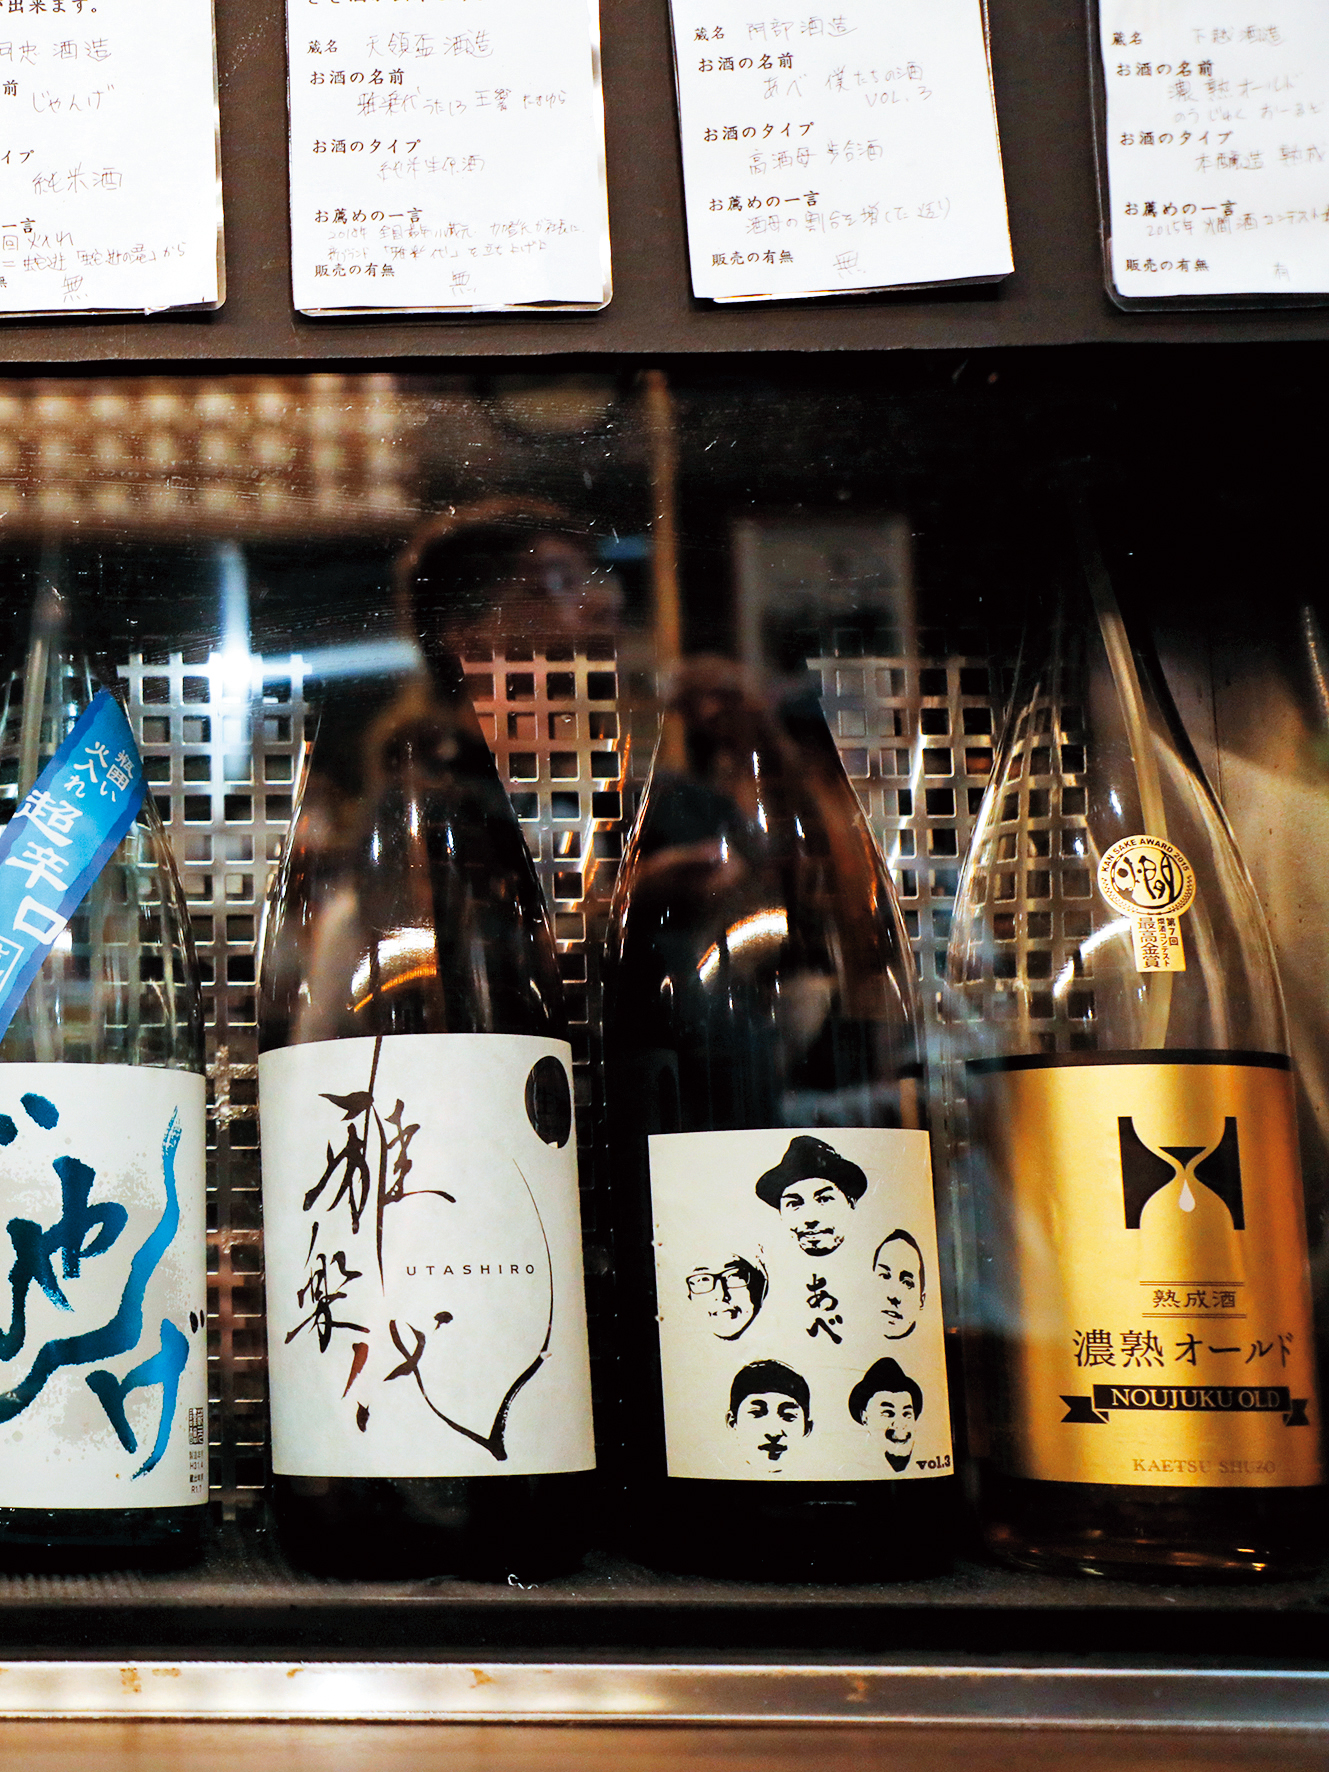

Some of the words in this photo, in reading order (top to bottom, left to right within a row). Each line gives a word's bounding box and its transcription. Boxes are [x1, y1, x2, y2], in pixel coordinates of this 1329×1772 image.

[693, 26, 725, 42] 蔵名
[1112, 31, 1143, 46] 蔵名
[307, 40, 338, 55] 蔵名
[698, 52, 794, 72] お酒の名前
[1116, 59, 1215, 78] お酒の名前
[310, 69, 405, 86] お酒の名前
[704, 121, 814, 142] お酒のタイプ
[1120, 130, 1234, 147] お酒のタイプ
[312, 139, 421, 155] お酒のタイプ
[32, 161, 123, 195] 純米酒
[709, 190, 820, 212] お薦めの一言
[1124, 201, 1237, 217] お薦めの一言
[315, 207, 423, 225] お薦めの一言
[711, 249, 794, 267] 販売の有無
[833, 251, 866, 279] 無
[1125, 257, 1210, 273] 販売の有無
[314, 263, 395, 278] 販売の有無
[61, 275, 88, 303] 無
[449, 269, 476, 297] 無
[63, 740, 110, 799] 火入れ
[99, 749, 135, 803] 瓶囲い
[1101, 854, 1115, 873] KAN
[1113, 838, 1138, 855] SAKE
[1139, 838, 1173, 853] AWARD
[1174, 852, 1190, 872] 2015
[5, 789, 84, 946] 超辛口
[407, 1264, 536, 1276] UTASHIRO
[806, 1273, 843, 1344] あべ
[1153, 1290, 1236, 1309] 熟成酒
[1111, 1388, 1232, 1409] NOUJUKU
[1237, 1390, 1280, 1409] OLD
[916, 1455, 951, 1470] vol.3
[1133, 1459, 1212, 1473] KAETSU
[1219, 1459, 1276, 1475] SHUZO
